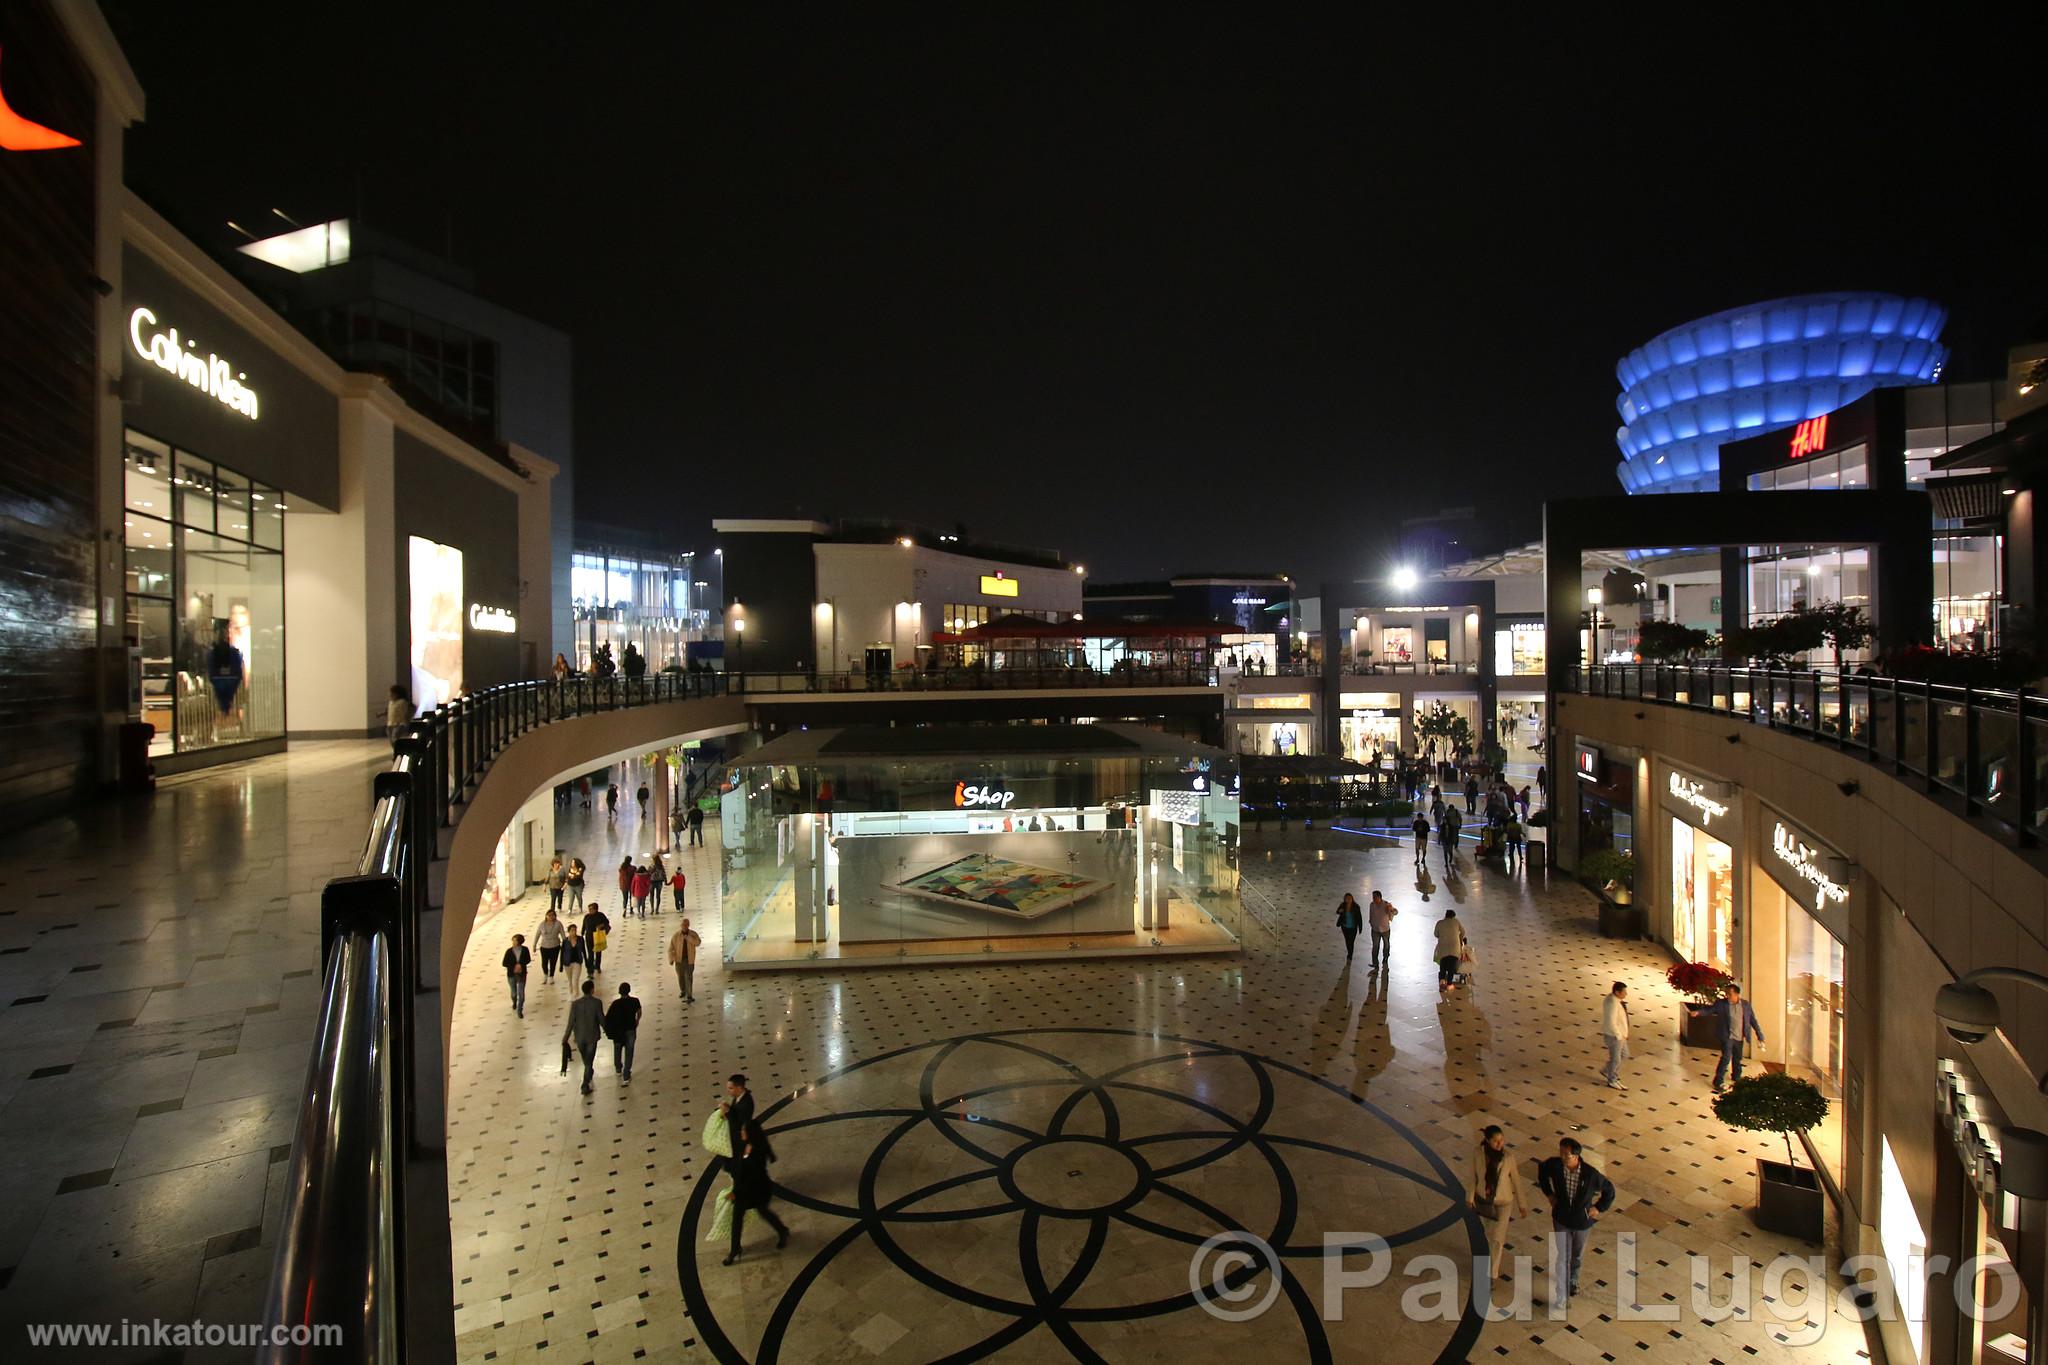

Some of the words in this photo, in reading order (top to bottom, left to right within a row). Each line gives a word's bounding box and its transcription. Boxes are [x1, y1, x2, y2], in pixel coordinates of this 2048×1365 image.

[131, 307, 208, 393] Calvin
[209, 353, 258, 420] Klein
[954, 781, 1015, 809] iShop
